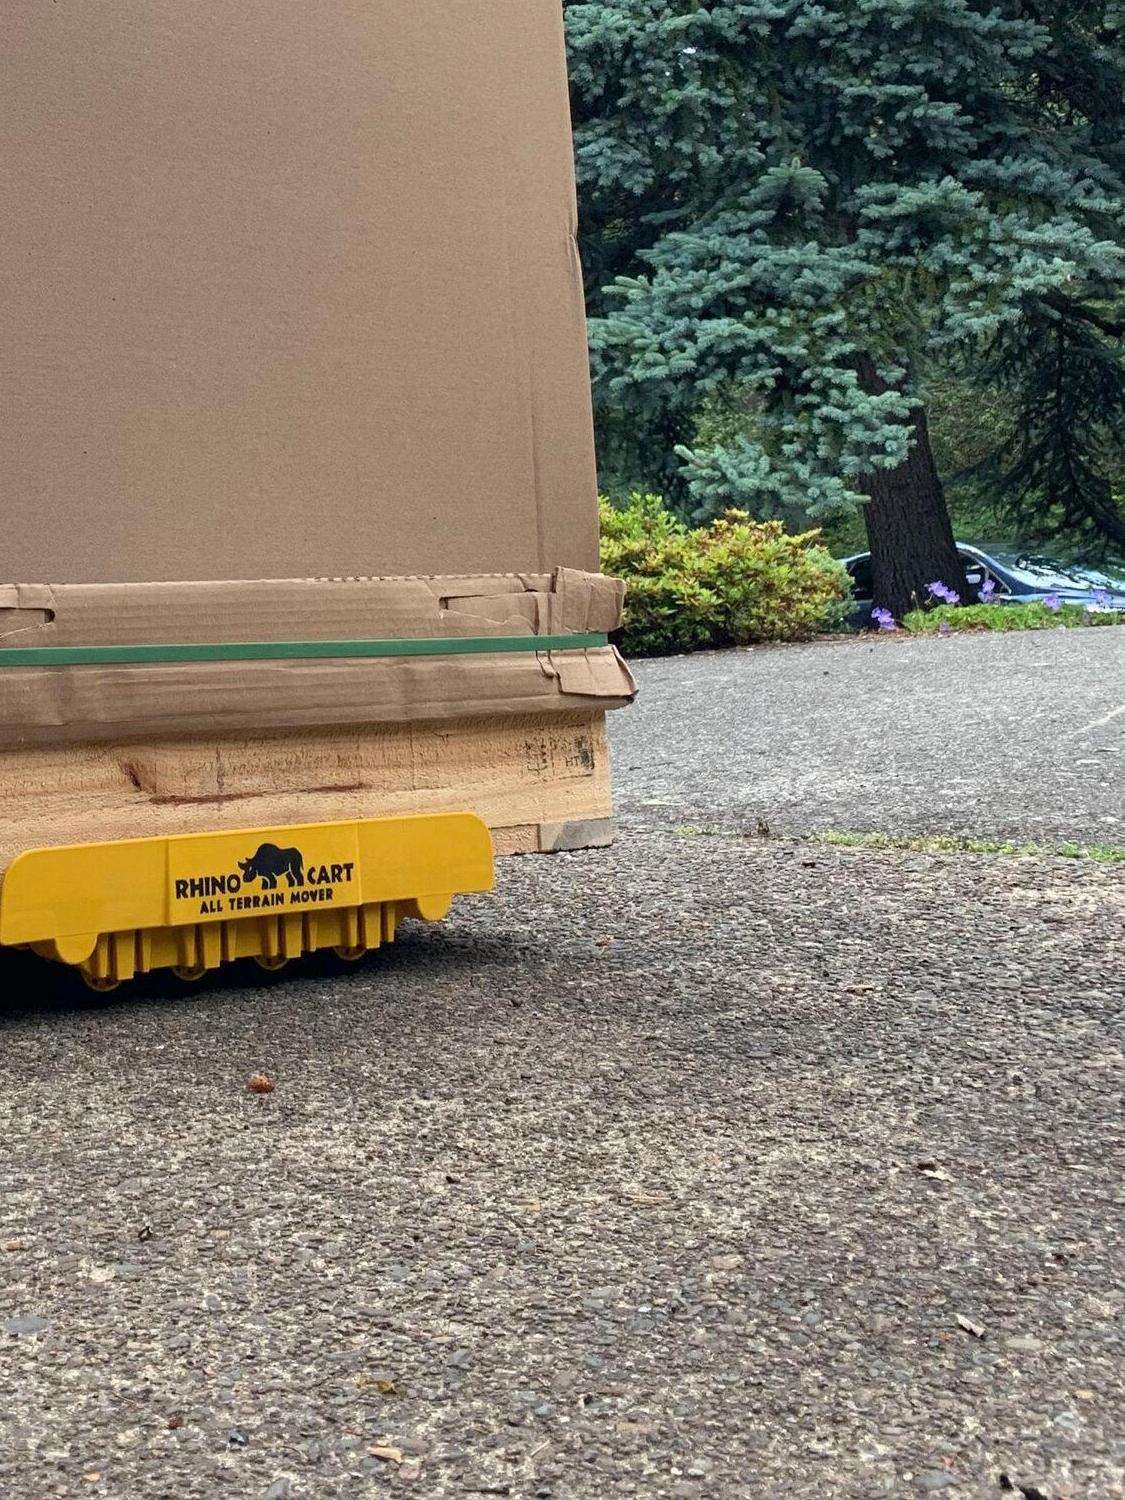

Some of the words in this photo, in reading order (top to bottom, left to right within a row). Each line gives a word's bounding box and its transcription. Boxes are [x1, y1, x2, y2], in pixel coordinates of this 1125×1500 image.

[175, 873, 241, 899] RHINO
[307, 862, 354, 885] CART
[200, 901, 223, 915] ALL
[228, 892, 285, 911] TERRAIN
[290, 888, 334, 904] MOVER
